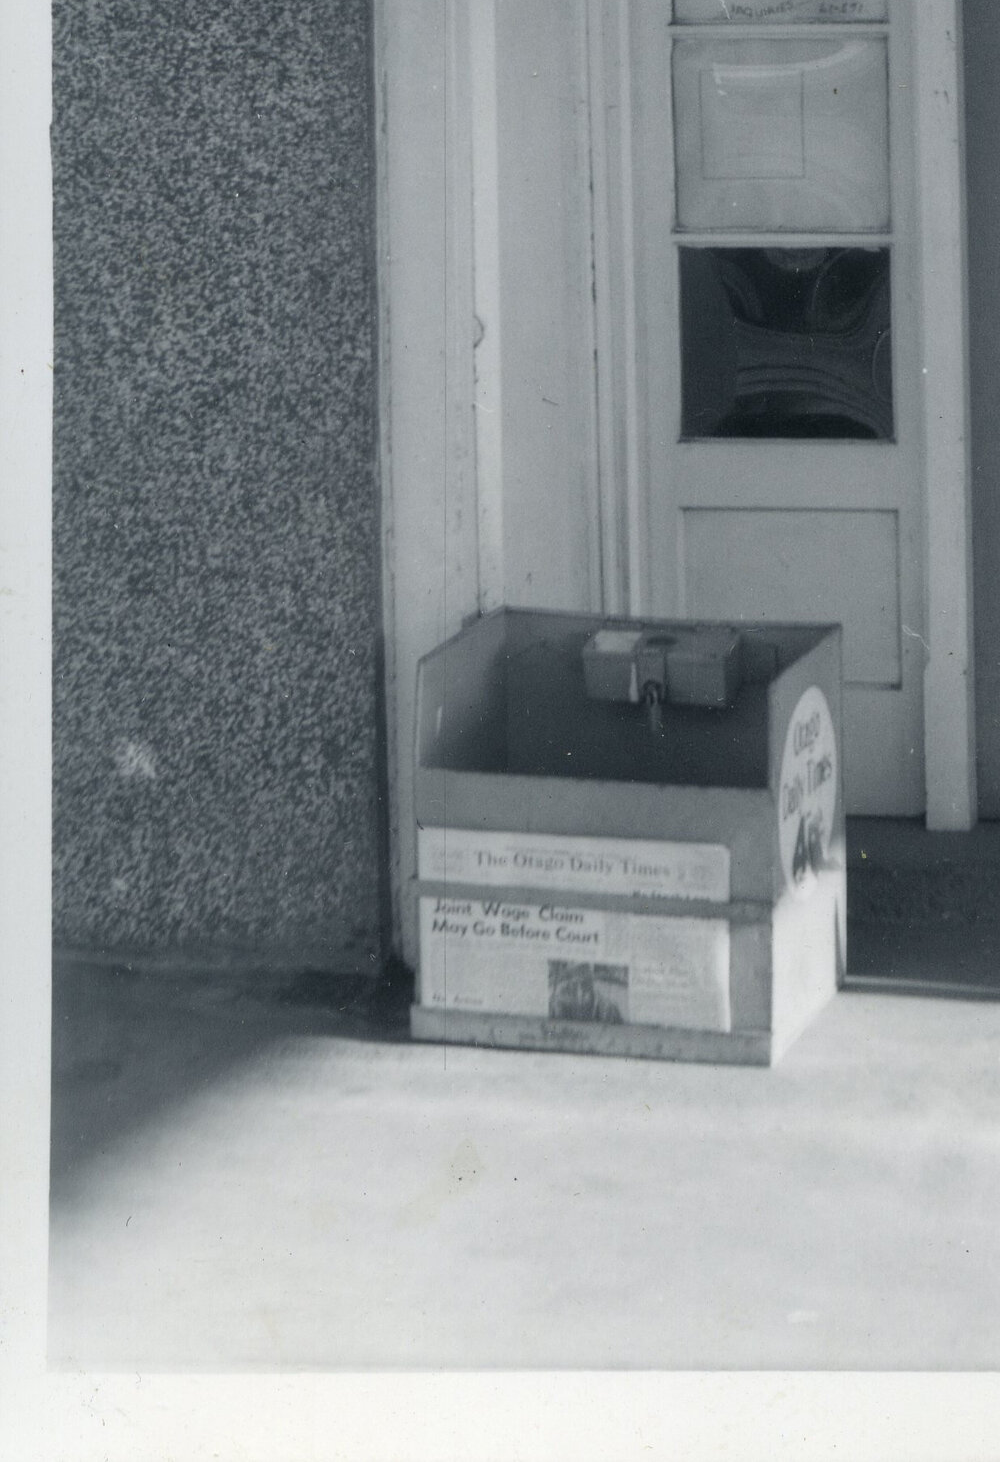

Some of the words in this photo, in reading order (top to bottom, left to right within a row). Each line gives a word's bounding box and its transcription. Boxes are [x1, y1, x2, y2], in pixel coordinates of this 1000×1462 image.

[475, 850, 508, 867] The
[512, 852, 565, 872] Otago
[569, 856, 613, 877] Daily
[620, 859, 671, 878] Times
[433, 898, 472, 917] Joint
[482, 900, 531, 920] Wage
[537, 905, 585, 924] Claim
[432, 918, 468, 937] May
[472, 920, 496, 937] Go
[500, 922, 550, 941] Before
[554, 926, 600, 944] Court
